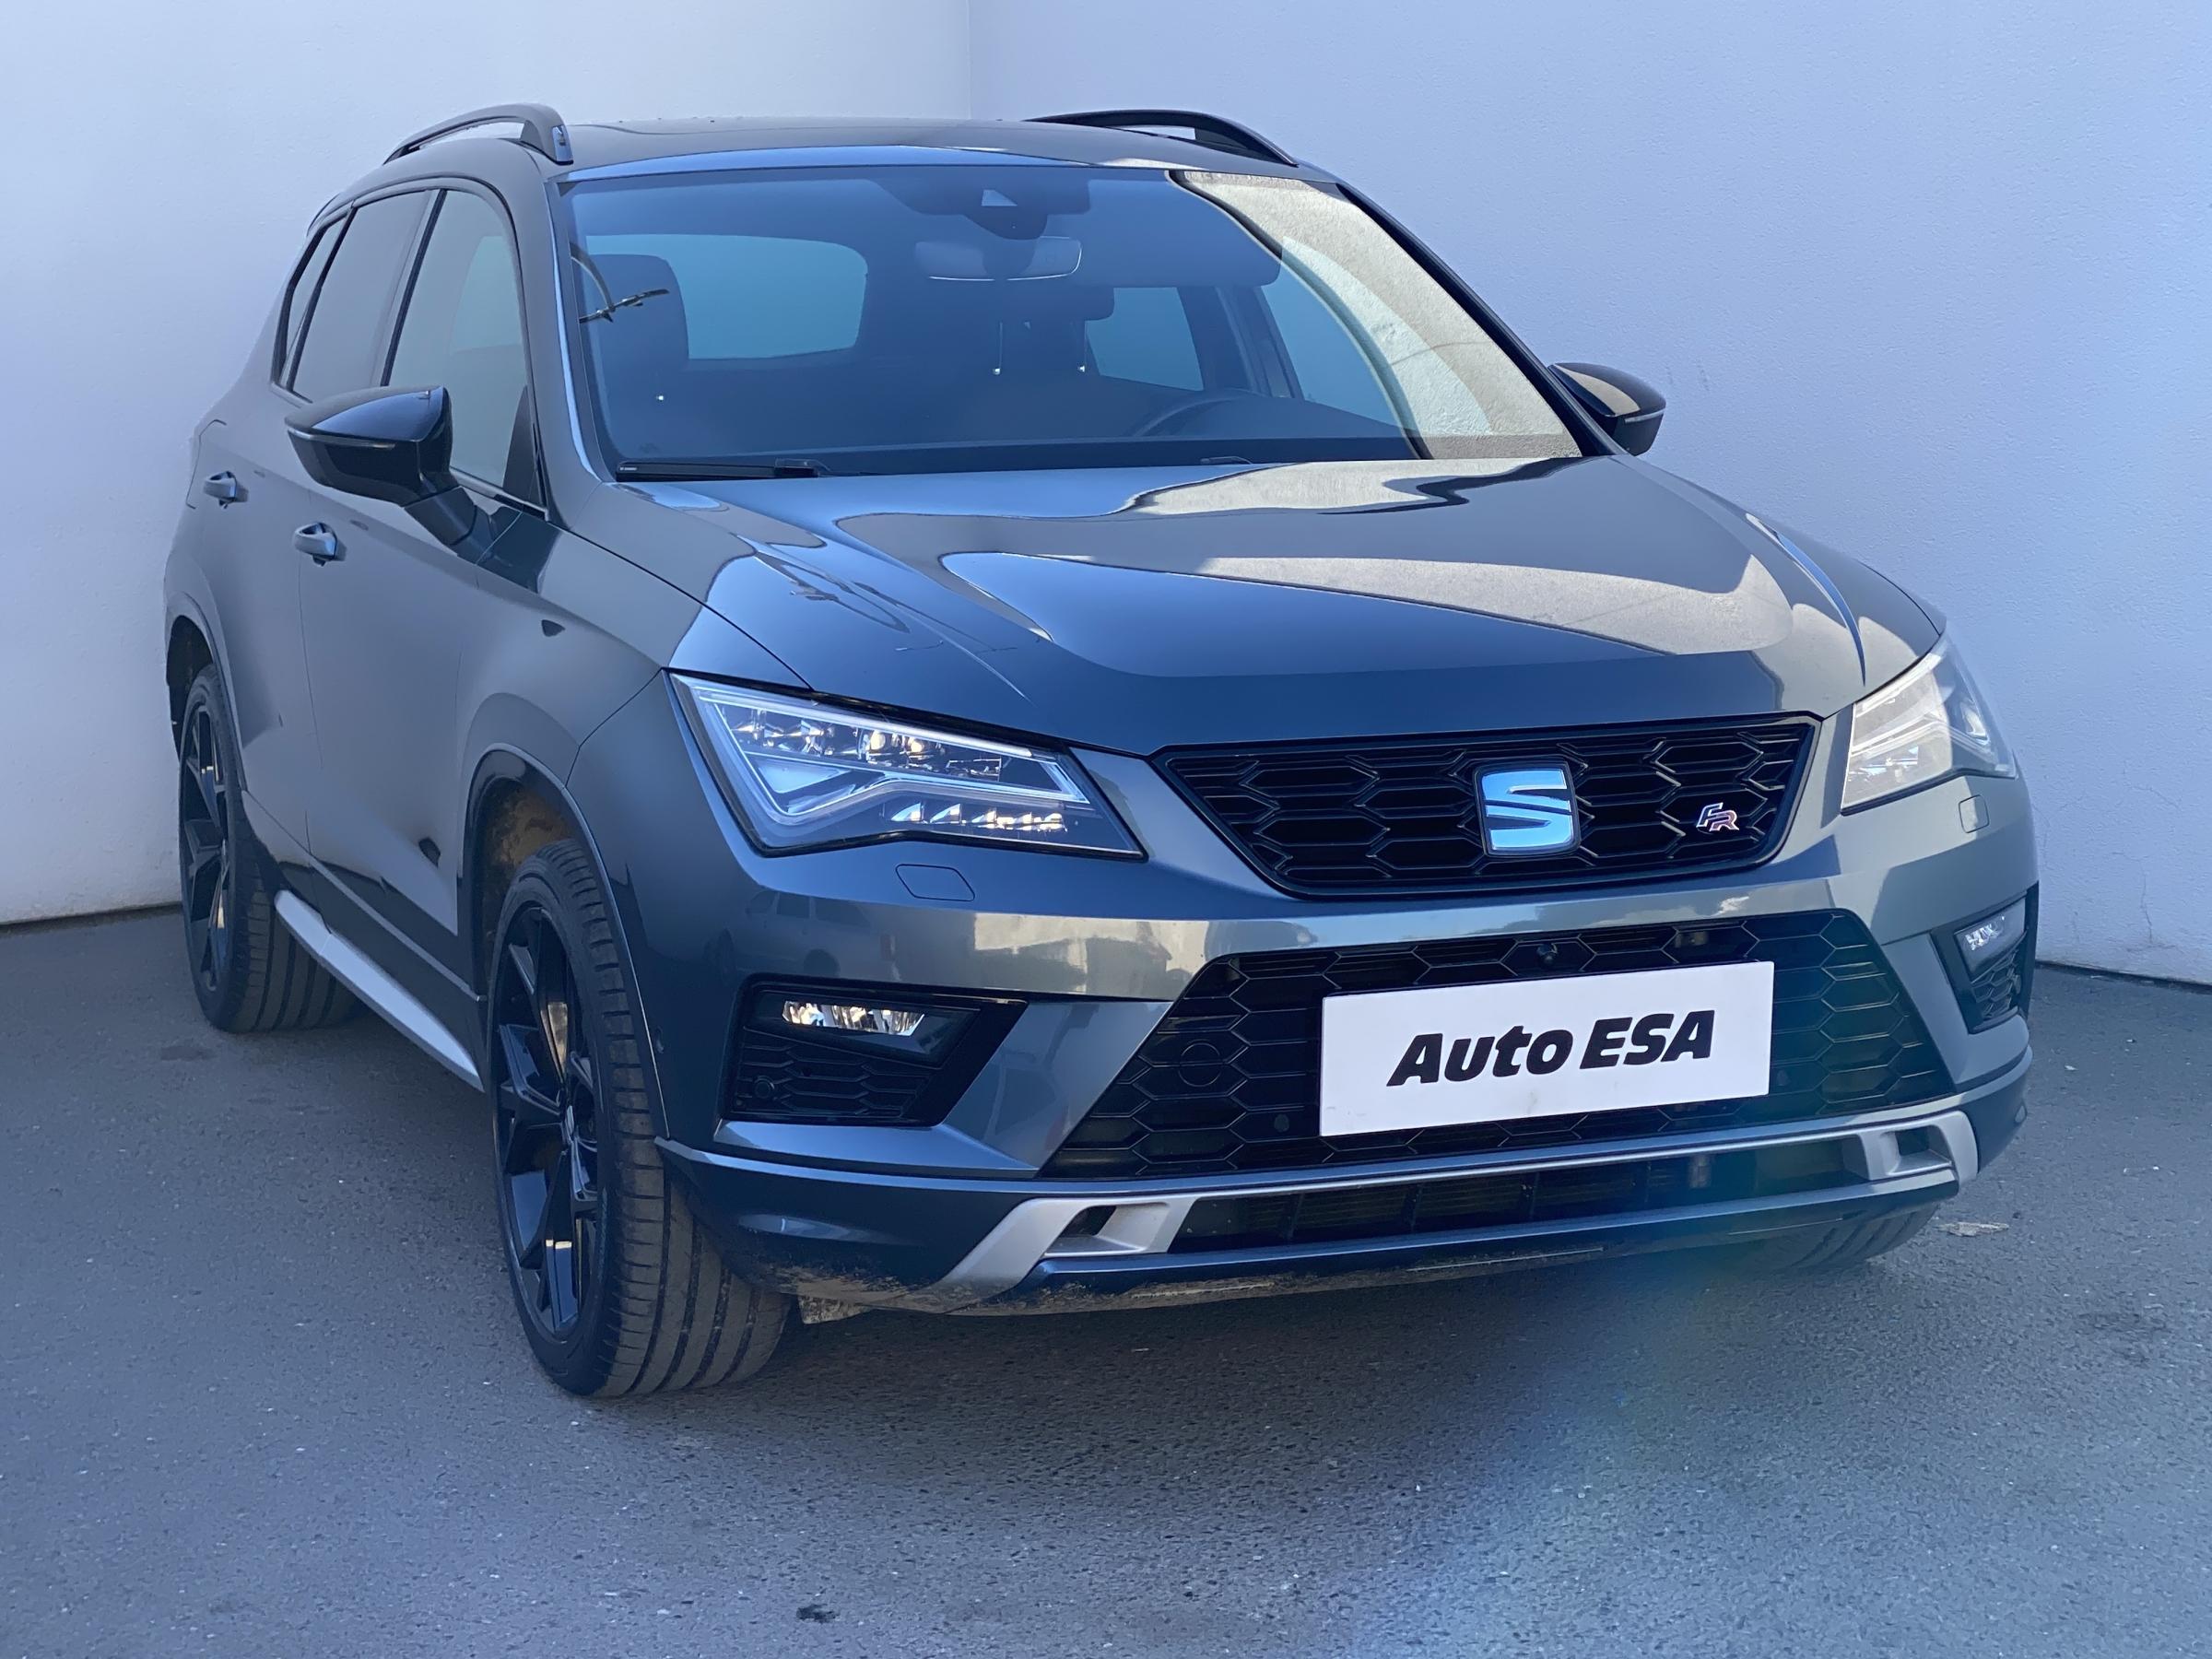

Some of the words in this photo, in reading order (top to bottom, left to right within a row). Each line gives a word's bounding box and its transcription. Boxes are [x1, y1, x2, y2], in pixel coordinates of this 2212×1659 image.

[1696, 802, 1740, 832] FR
[1385, 1025, 1573, 1088] Auto
[1579, 1009, 1716, 1070] ESA
